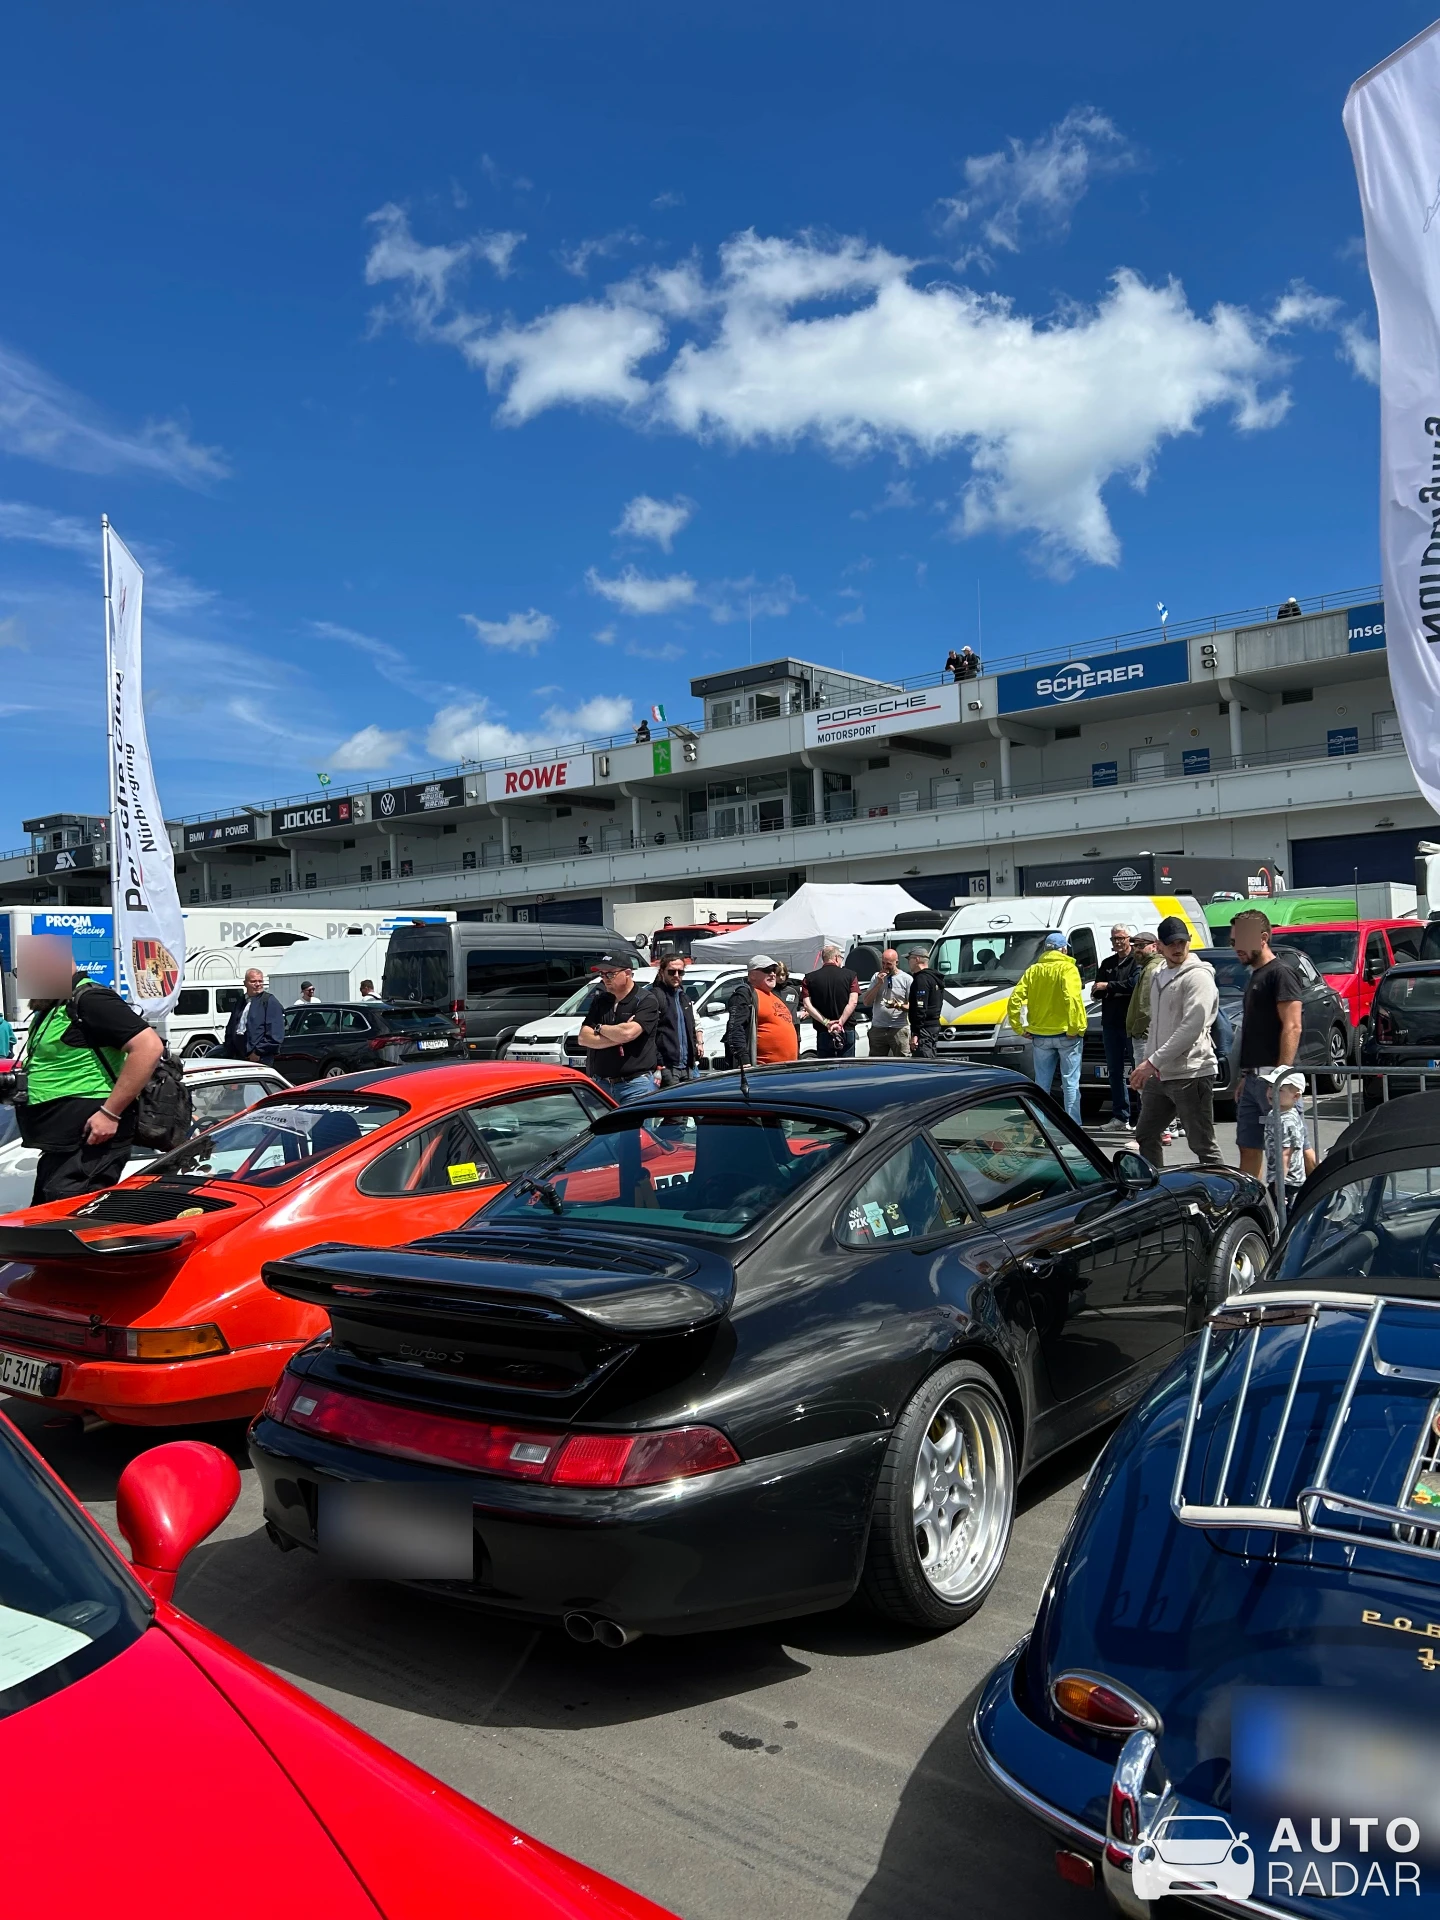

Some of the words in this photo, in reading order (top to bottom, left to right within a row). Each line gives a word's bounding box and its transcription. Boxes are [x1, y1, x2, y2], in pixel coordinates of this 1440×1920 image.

[1348, 623, 1386, 640] unse
[1036, 663, 1145, 696] SCHERER
[816, 695, 927, 725] PORSCHE
[817, 724, 877, 744] MOTORSPORT
[1144, 736, 1154, 745] 17
[504, 762, 568, 795] ROWE
[941, 767, 950, 776] 16
[279, 807, 332, 830] JOCKEL
[189, 831, 205, 843] BMW
[225, 824, 250, 837] POWER
[971, 878, 985, 893] 16
[45, 915, 92, 927] PROOM
[518, 911, 529, 922] 15
[73, 925, 106, 938] Racing
[848, 1216, 870, 1231] PZK
[399, 1342, 448, 1361] turbo
[450, 1350, 465, 1363] S
[2, 1357, 13, 1383] C
[12, 1362, 40, 1393] 31H
